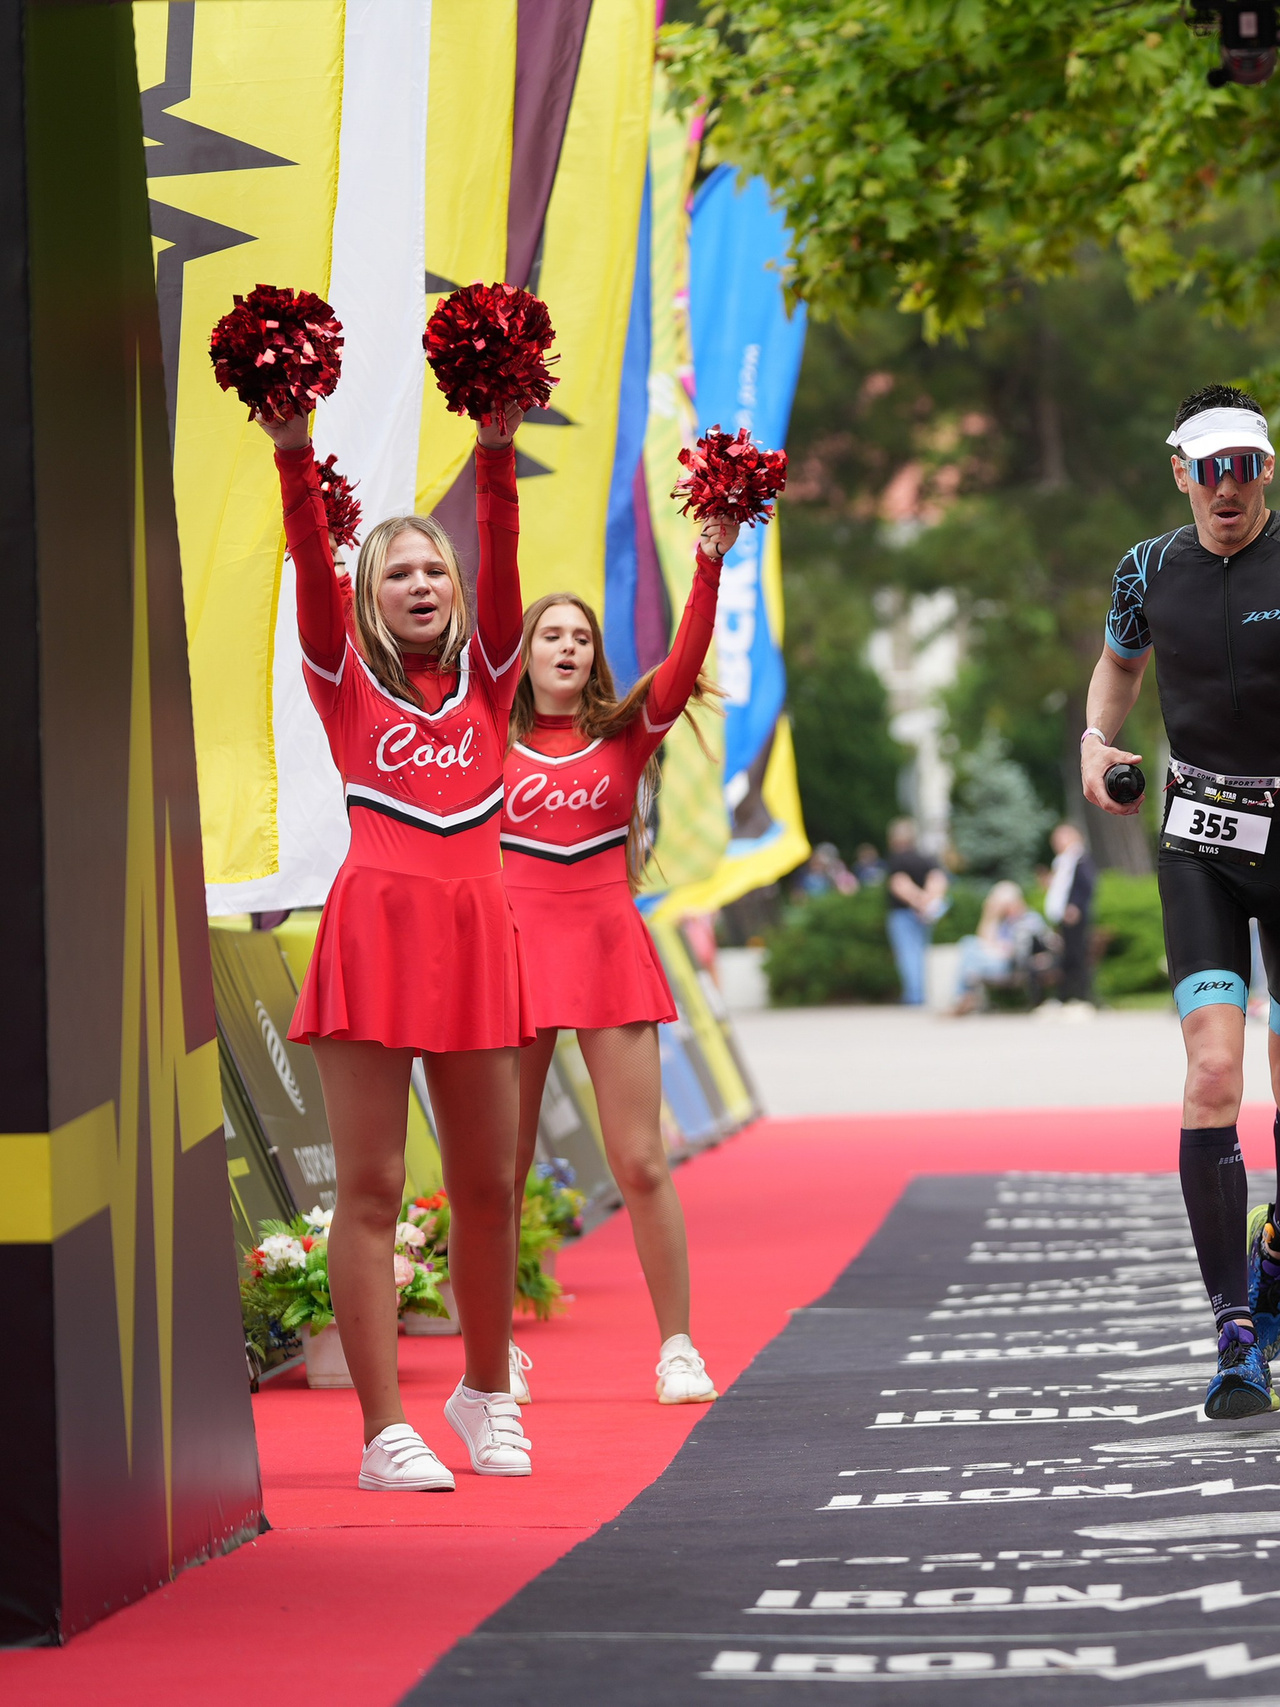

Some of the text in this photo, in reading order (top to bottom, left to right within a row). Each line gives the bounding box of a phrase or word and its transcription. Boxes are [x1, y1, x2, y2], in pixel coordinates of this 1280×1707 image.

[376, 723, 474, 772] Cool
[506, 773, 610, 823] Cool
[1204, 786, 1218, 796] IRON
[1221, 791, 1237, 801] STAR
[1189, 809, 1239, 842] 355
[1198, 844, 1220, 855] ILYAS
[907, 1340, 1139, 1361] IRON
[874, 1404, 1140, 1425] IRON
[827, 1483, 1133, 1507] IRON
[754, 1583, 1123, 1608] IRON
[711, 1645, 1117, 1673] IRON
